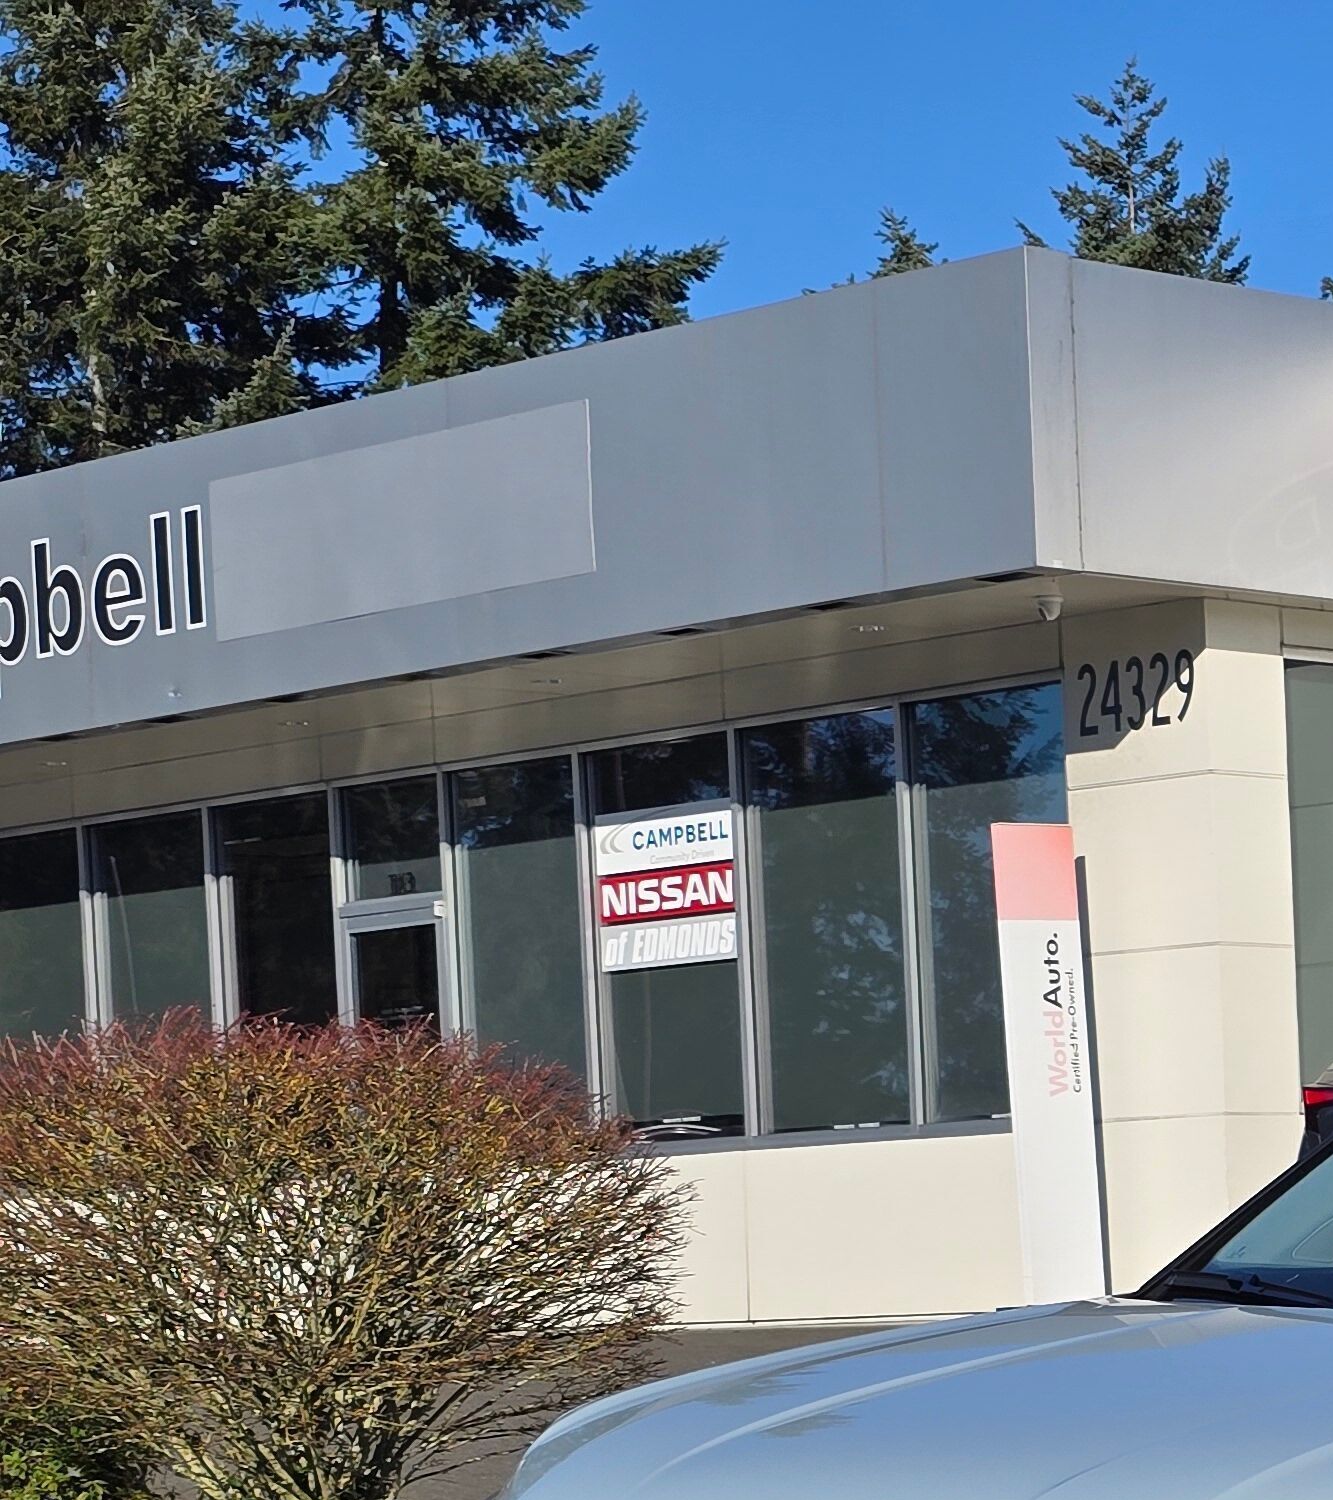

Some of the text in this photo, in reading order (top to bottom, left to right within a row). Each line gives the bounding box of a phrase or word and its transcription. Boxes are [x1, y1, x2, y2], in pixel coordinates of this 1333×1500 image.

[1077, 648, 1195, 737] 24329
[632, 819, 729, 851] CAMPBELL
[601, 869, 734, 918] NISSAN
[604, 918, 736, 967] of EDMONDS
